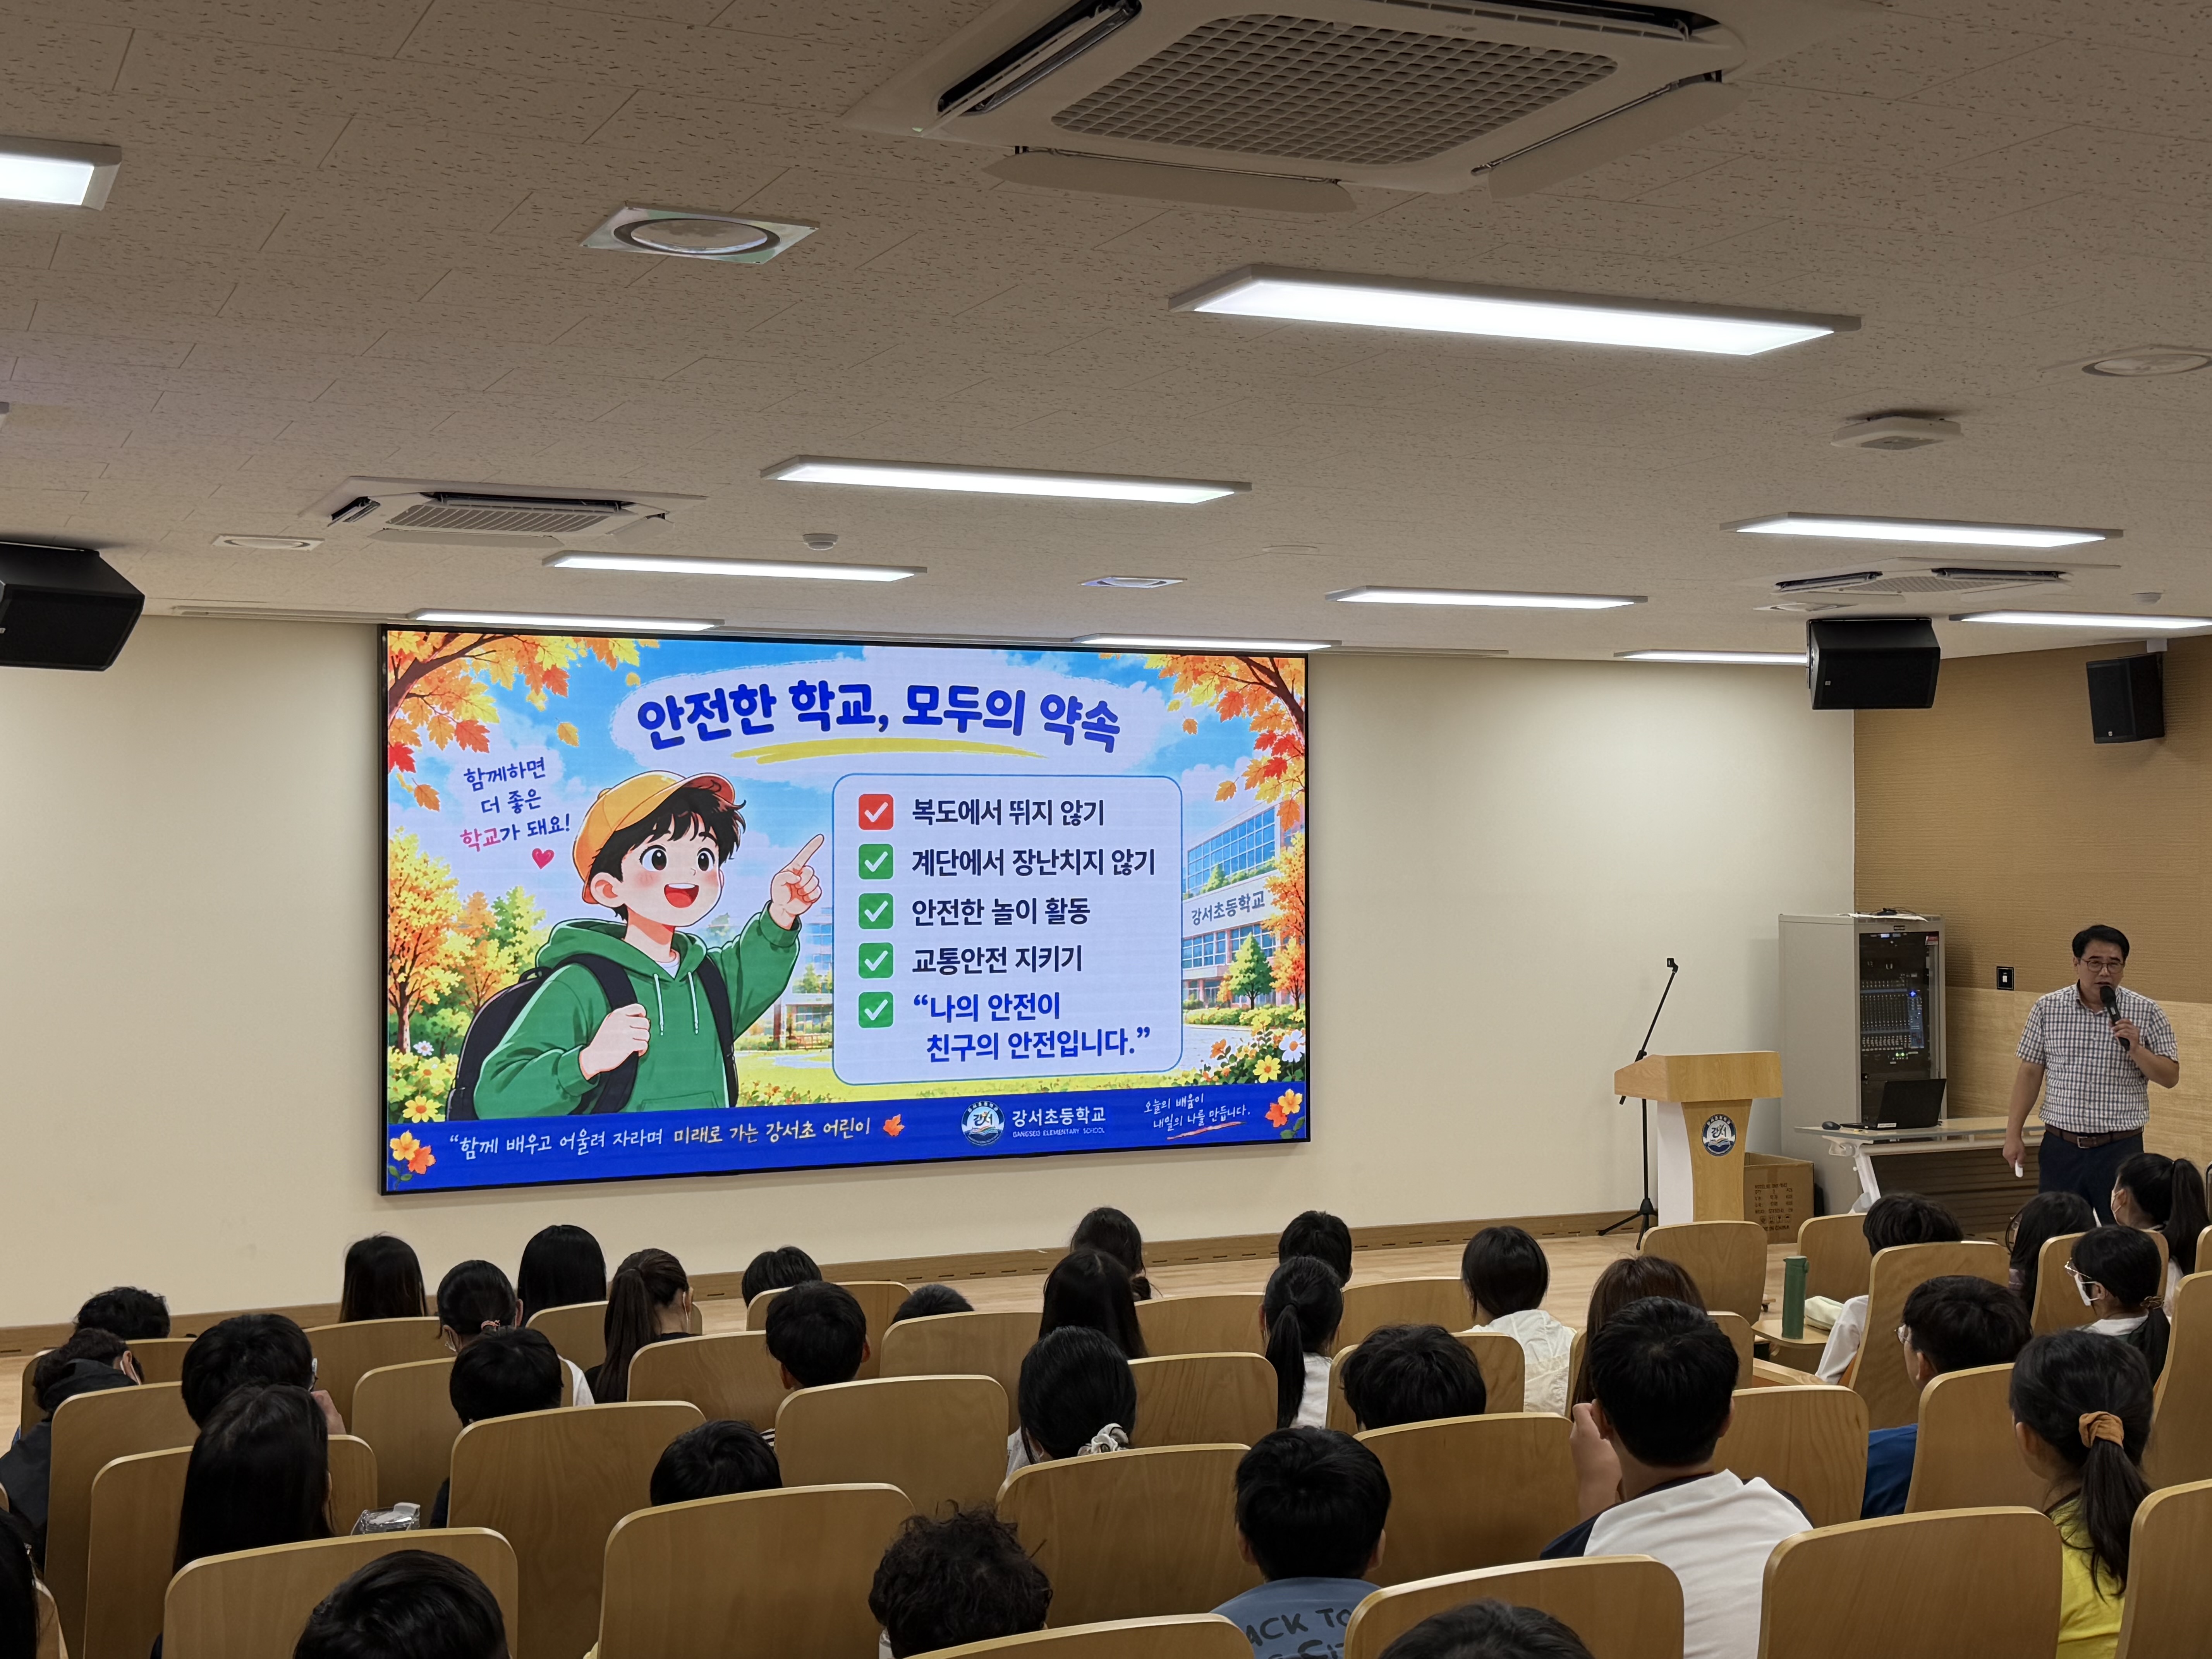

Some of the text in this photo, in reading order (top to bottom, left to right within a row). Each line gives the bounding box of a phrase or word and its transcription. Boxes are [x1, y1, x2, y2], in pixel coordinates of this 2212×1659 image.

[637, 680, 1120, 753] 안전한 학교, 모두의 약속
[463, 756, 546, 792] 함께하면
[481, 788, 541, 814] 더 좋은
[912, 799, 1104, 826] 복도에서 뛰지 않기
[460, 813, 570, 852] 학교가 돼요!
[912, 848, 1154, 877] 계단에서 장난치지 않기
[912, 897, 1091, 926] 안전한 놀이 활동
[1192, 890, 1265, 926] 강서초등학교
[912, 945, 1082, 975] 교통안전 지키기
[914, 992, 1060, 1023] “나의 안전이
[927, 1032, 999, 1063] 친구의
[1012, 1106, 1106, 1128] 강서초등학교
[1144, 1093, 1204, 1115] 오늘의 배움이
[1153, 1113, 1183, 1132] 내일의
[1187, 1109, 1206, 1127] 나를
[507, 1133, 552, 1155] 배우고
[560, 1128, 605, 1156] 어울려
[613, 1128, 663, 1147] 자라며
[674, 1126, 723, 1144] 미래로
[729, 1123, 759, 1143] 가는
[766, 1120, 816, 1143] 강서초
[823, 1117, 870, 1139] 어린이
